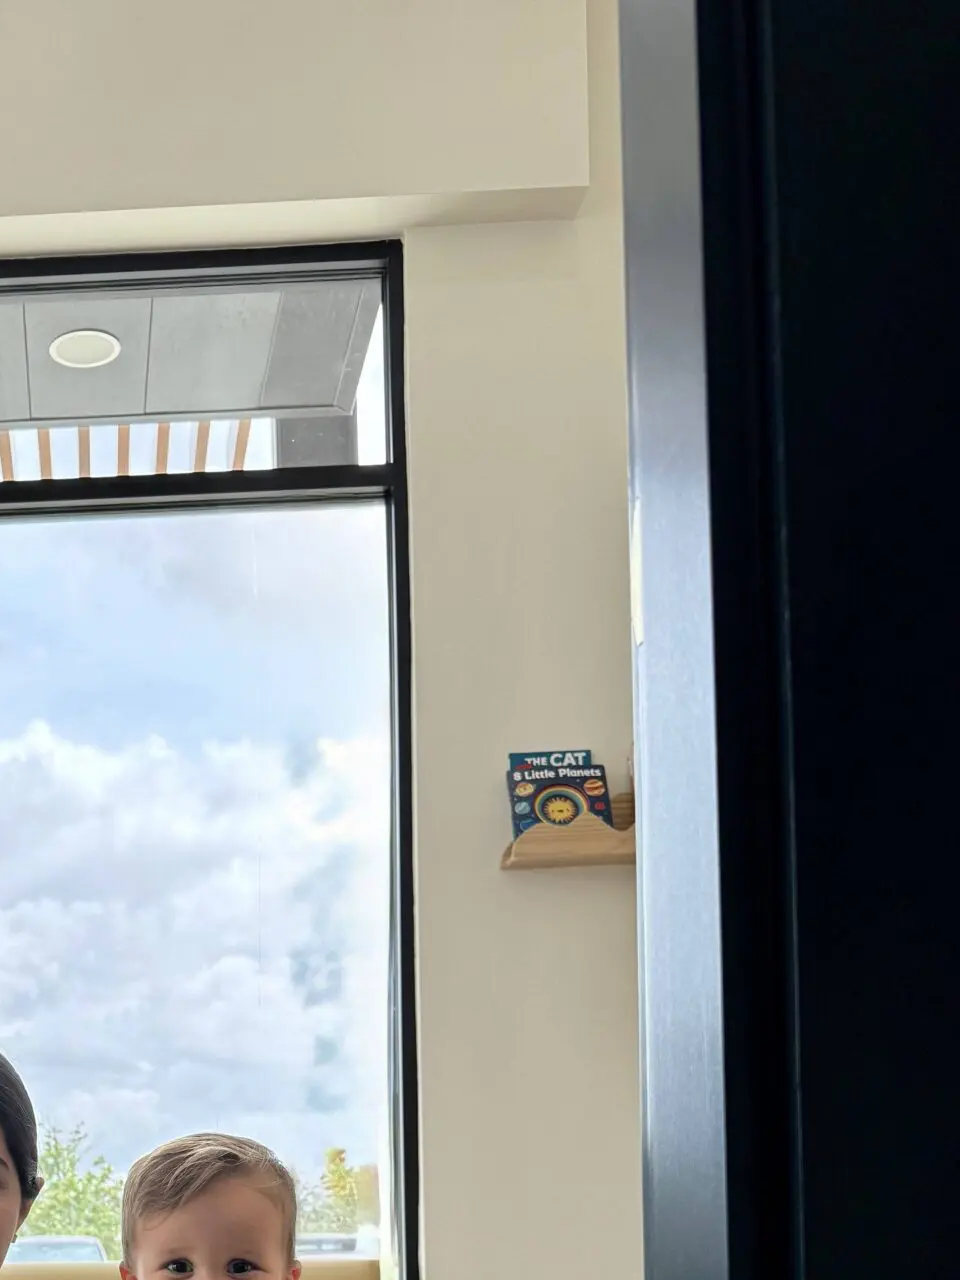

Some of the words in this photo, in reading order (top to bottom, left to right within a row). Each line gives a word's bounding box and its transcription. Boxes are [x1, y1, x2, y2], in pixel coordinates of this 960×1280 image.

[524, 757, 547, 766] THE
[550, 752, 587, 766] CAT
[513, 772, 521, 781] 8
[525, 770, 555, 780] Little
[558, 768, 601, 777] Planets
